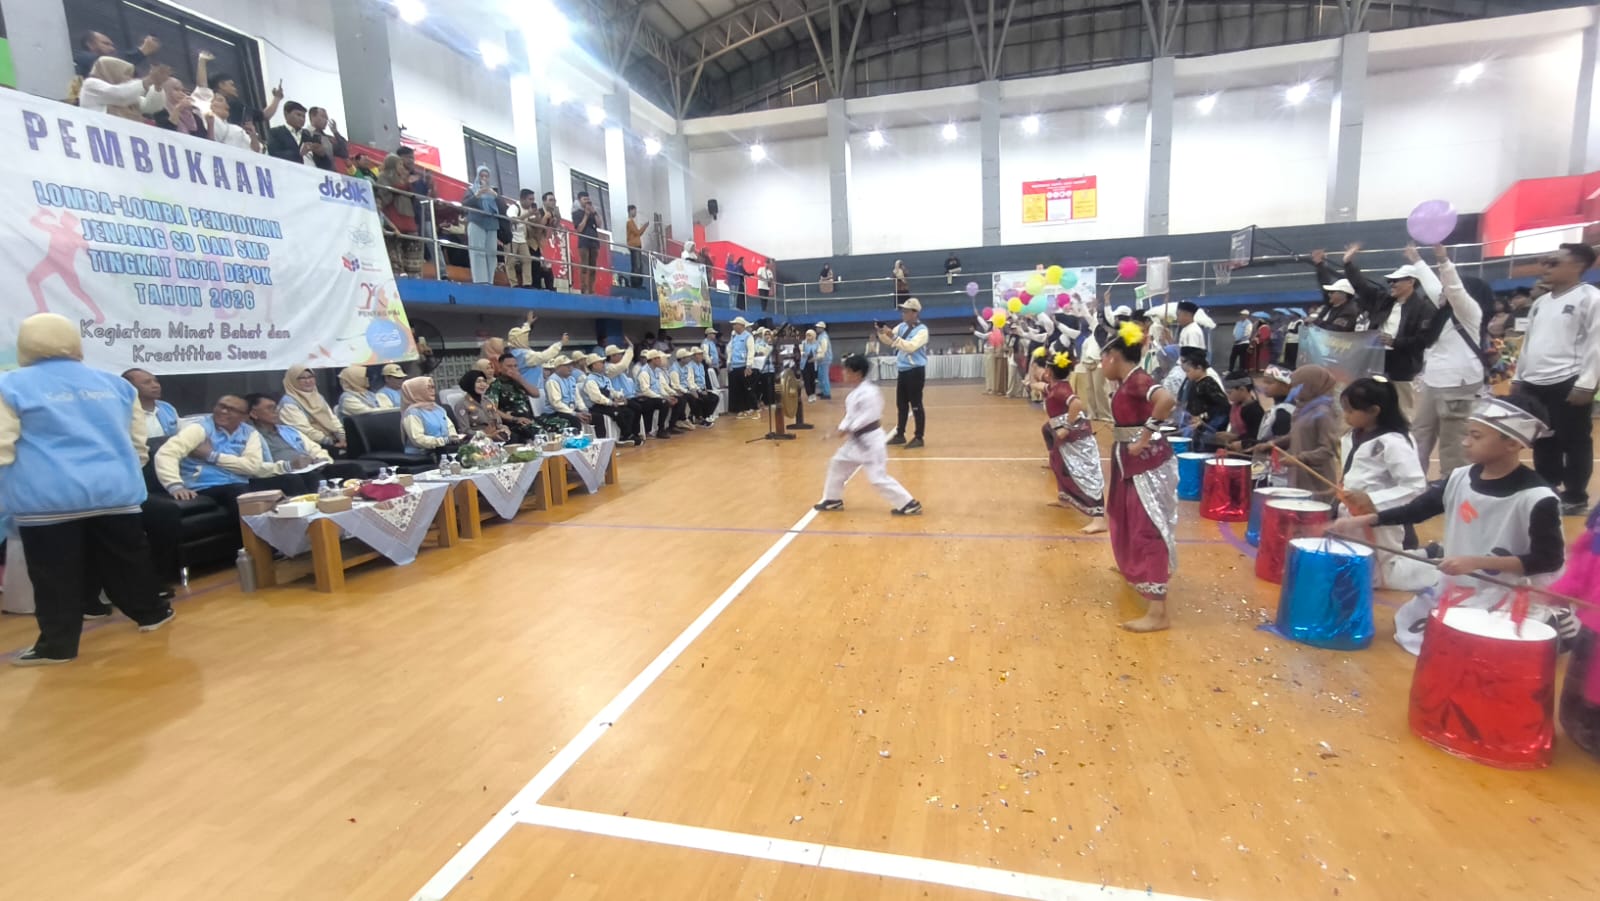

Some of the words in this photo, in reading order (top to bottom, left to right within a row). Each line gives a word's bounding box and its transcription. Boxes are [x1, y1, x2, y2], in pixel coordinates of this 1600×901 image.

[22, 109, 275, 199] PEMBUKAAN
[33, 180, 188, 226] LOMBA-LOMBA
[188, 206, 283, 239] PENDIDIKAN
[80, 217, 169, 250] JENJANG
[169, 230, 196, 253] SD
[197, 234, 235, 257] DAN
[235, 239, 270, 261] SMP
[86, 248, 171, 278] TINGKAT
[175, 257, 222, 282] KOTA
[223, 262, 273, 286] DEPOK
[134, 282, 203, 308] TAHUN
[208, 287, 256, 311] 2026
[80, 318, 162, 347] Kegiatan
[167, 320, 215, 340] Minat
[220, 321, 262, 339] Bakat
[267, 324, 290, 339] dan
[131, 344, 222, 363] Kreatifitas
[226, 343, 268, 361] Siswa
